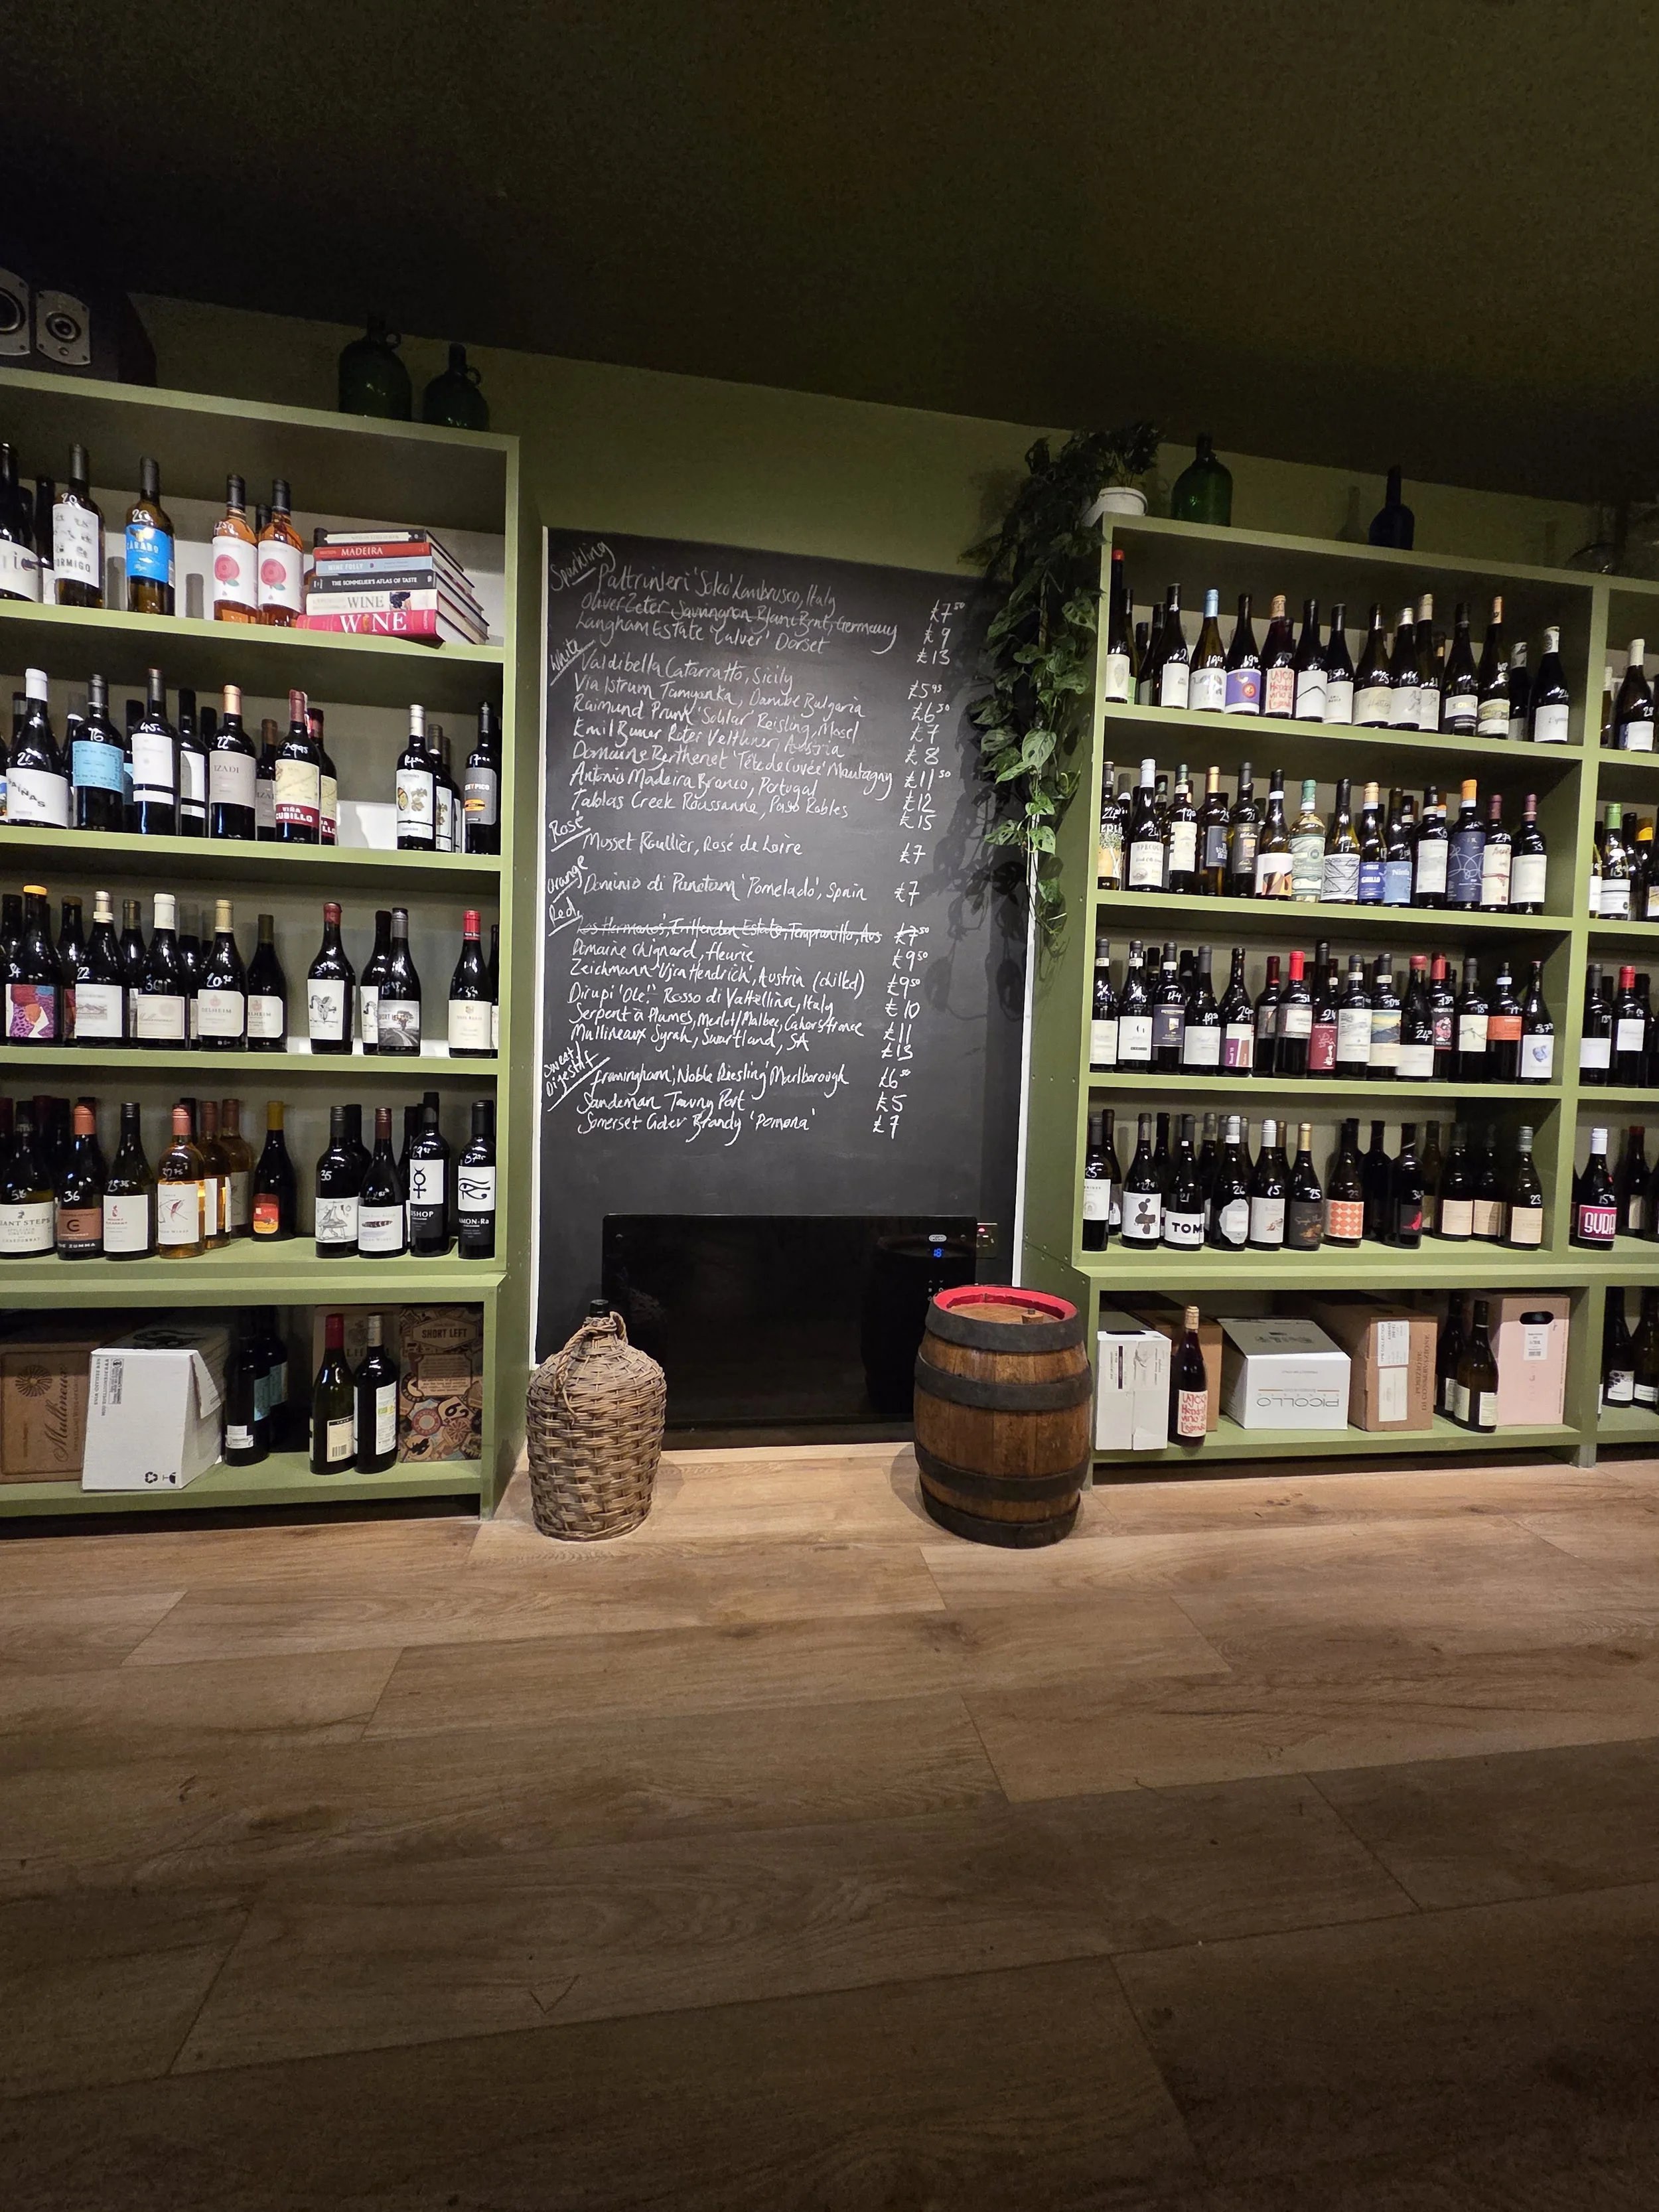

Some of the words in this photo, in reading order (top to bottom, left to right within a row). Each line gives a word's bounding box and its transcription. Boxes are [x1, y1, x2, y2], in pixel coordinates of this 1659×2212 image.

[340, 546, 384, 557] MADEIRA
[550, 541, 616, 591] Sparkling
[347, 596, 384, 609] WINE
[581, 591, 626, 611] Oliver
[575, 611, 649, 648] Langham
[652, 619, 705, 640] Estate
[774, 631, 831, 654] Dorset
[550, 637, 583, 672] White
[916, 647, 950, 665] £13
[581, 648, 665, 678] Valdibella
[751, 665, 793, 696] Sicily
[574, 672, 600, 693] Via
[749, 688, 800, 708] Danube
[800, 692, 866, 723] Bulgaria
[573, 694, 644, 720] Raimund
[818, 721, 859, 744] Mosel
[573, 717, 614, 737] Emil
[573, 740, 649, 764] Domaine
[569, 761, 625, 786] Antonio
[627, 768, 695, 790] Madeira
[758, 776, 818, 804] Portugal
[571, 787, 625, 811] Tablas
[630, 790, 676, 809] Creek
[769, 795, 800, 814] Paso
[806, 796, 849, 819] Robles
[902, 789, 936, 814] £12
[549, 810, 584, 844] Rosé
[899, 810, 937, 831] £15
[703, 832, 734, 853] Rosé
[740, 834, 759, 853] de
[762, 833, 803, 855] Loire
[899, 842, 926, 865] £7
[547, 855, 588, 894] Orange
[646, 873, 666, 892] di
[672, 872, 741, 901] Punctum
[826, 881, 868, 903] Spain
[894, 881, 920, 907] £7
[572, 938, 627, 958] Domaine
[76, 966, 90, 980] 22
[569, 958, 653, 977] Zeichmann
[758, 966, 805, 988] Austria
[567, 982, 614, 1008] Dirupi
[664, 987, 701, 1004] Rosso
[706, 987, 721, 1004] di
[803, 993, 834, 1017] Italy
[885, 997, 920, 1020] £10
[569, 1003, 631, 1025] Serpent
[650, 1024, 698, 1052] Syrah,
[786, 1033, 810, 1051] SA
[881, 1042, 914, 1062] £13
[769, 1063, 849, 1098] Marlborough
[576, 1092, 662, 1114] Sandeman
[718, 1088, 745, 1111] Port
[875, 1092, 907, 1113] £5
[577, 1111, 643, 1134] Somerset
[646, 1112, 688, 1131] Cider
[685, 1111, 742, 1146] Brandy
[873, 1114, 900, 1140] £7
[63, 1191, 80, 1203] 36
[1232, 1185, 1246, 1195] 26
[23, 1217, 51, 1226] STEPS
[1171, 1221, 1202, 1234] TOM
[422, 1329, 447, 1339] SHORT
[449, 1328, 467, 1338] LEFT
[1256, 1397, 1340, 1408] PICOLLO
